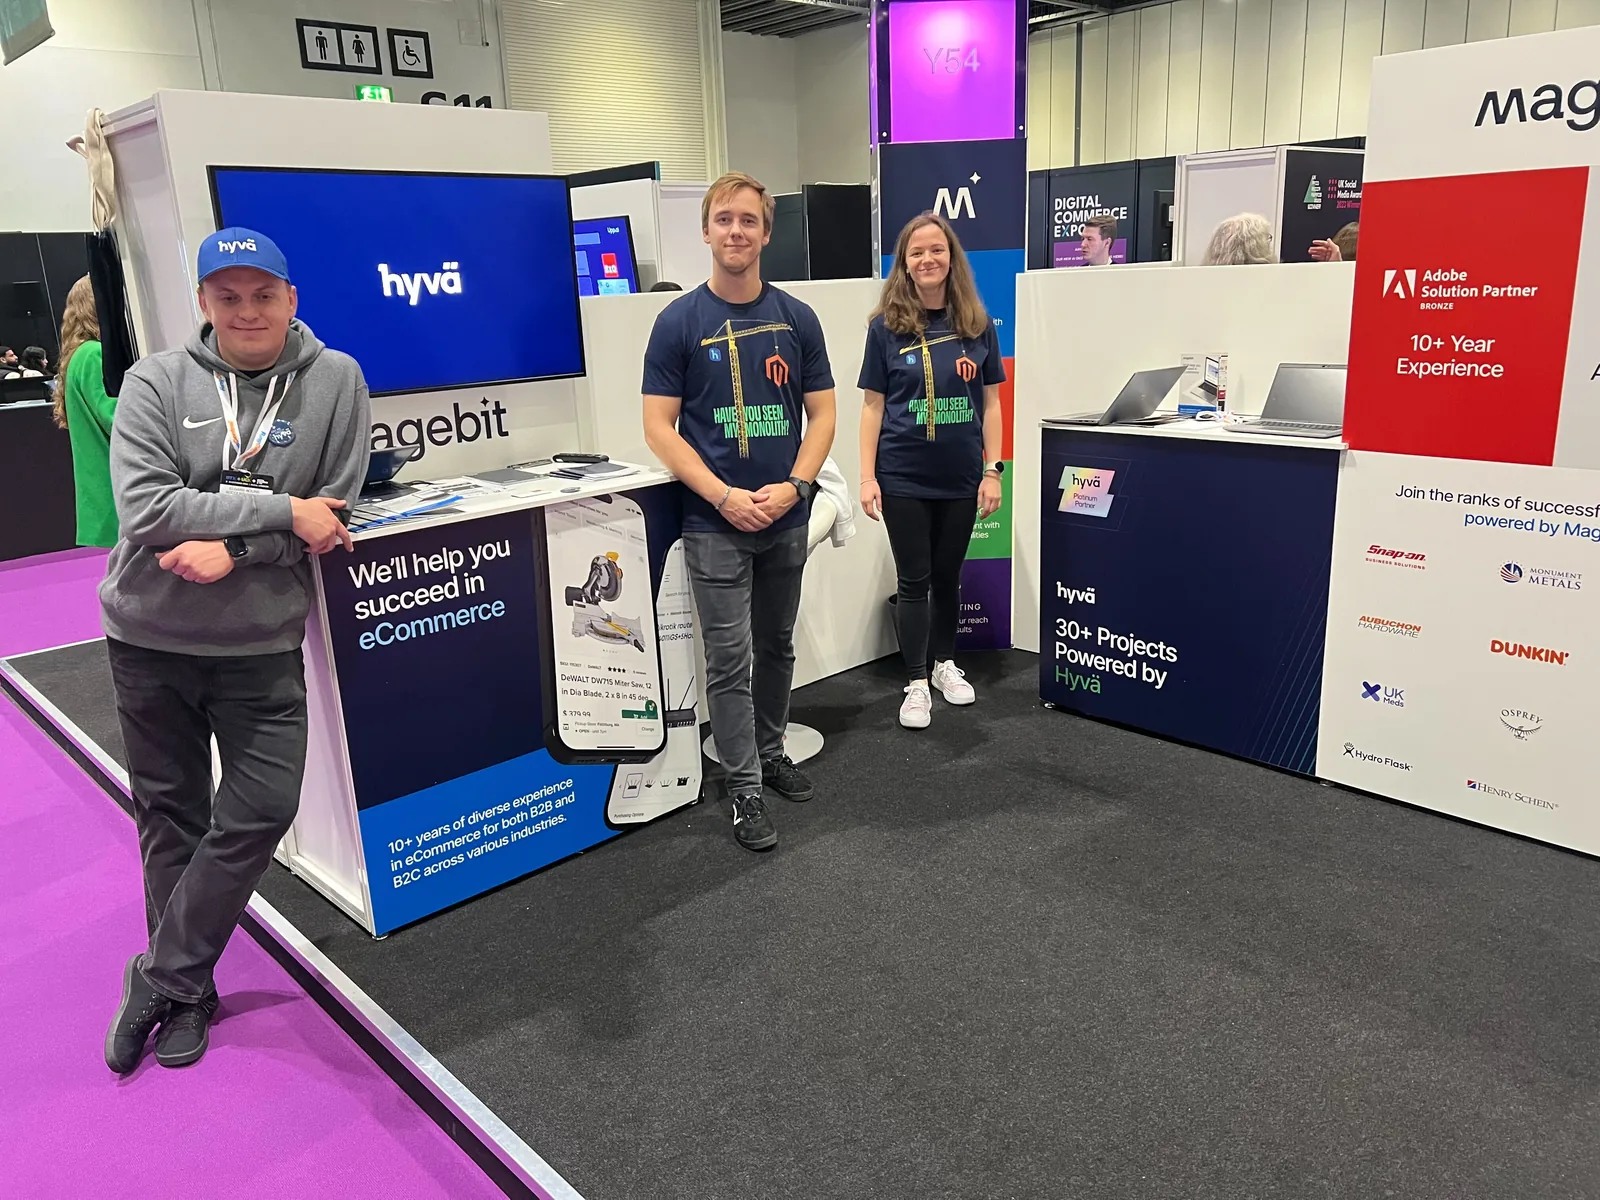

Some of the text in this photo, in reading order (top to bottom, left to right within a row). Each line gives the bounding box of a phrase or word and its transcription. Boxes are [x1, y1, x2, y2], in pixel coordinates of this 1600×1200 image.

[923, 46, 980, 75] Y54
[1054, 195, 1101, 210] DIGITAL
[377, 261, 462, 306] hyvä
[1422, 268, 1468, 282] Adobe
[1421, 285, 1538, 298] Solution Partner
[1420, 302, 1454, 310] BRONZE
[1410, 334, 1495, 352] 10+ Year
[1396, 358, 1504, 378] Experience
[934, 398, 948, 411] YOU
[950, 396, 968, 410] SEEN
[713, 404, 784, 424] HAVE YOU SEEN
[916, 409, 974, 424] MY MONOLITH?
[371, 396, 509, 462] agebit
[724, 420, 790, 438] MY MONOLITH?
[1072, 474, 1100, 489] hyvä
[1074, 492, 1098, 502] Platinum
[1075, 500, 1096, 508] Partner
[1396, 485, 1600, 518] Join the ranks of successf
[1464, 513, 1600, 542] powered by Mag
[1366, 544, 1426, 561] Snap-on
[348, 540, 511, 588] We'll help you
[1394, 562, 1425, 570] SOLUTIONS
[1530, 568, 1582, 580] MONUMENT
[1528, 576, 1582, 590] METALS
[354, 572, 485, 620] succeed in
[1056, 581, 1096, 604] hyvä
[359, 600, 505, 650] eCommerce
[1358, 622, 1419, 638] HARDWARE
[1359, 616, 1422, 632] AUBUCHON
[1056, 618, 1178, 662] 30+ Projects
[1490, 640, 1569, 665] DUNKIN'
[1056, 641, 1168, 690] Powered by
[560, 674, 589, 683] DeWALT
[591, 676, 613, 685] DW715
[614, 679, 630, 687] Miter
[1056, 665, 1101, 694] Hyvä
[583, 689, 604, 698] Blade,
[1384, 686, 1404, 700] UK
[1383, 697, 1404, 707] Meds
[1501, 709, 1543, 724] OSPREY
[1356, 750, 1410, 771] Hydro Flask
[1478, 782, 1514, 799] HENRY
[388, 778, 573, 854] 10+ years of diverse experience
[390, 792, 575, 871] in eCommerce for both B2B and
[393, 813, 567, 889] B2C across various industries.
